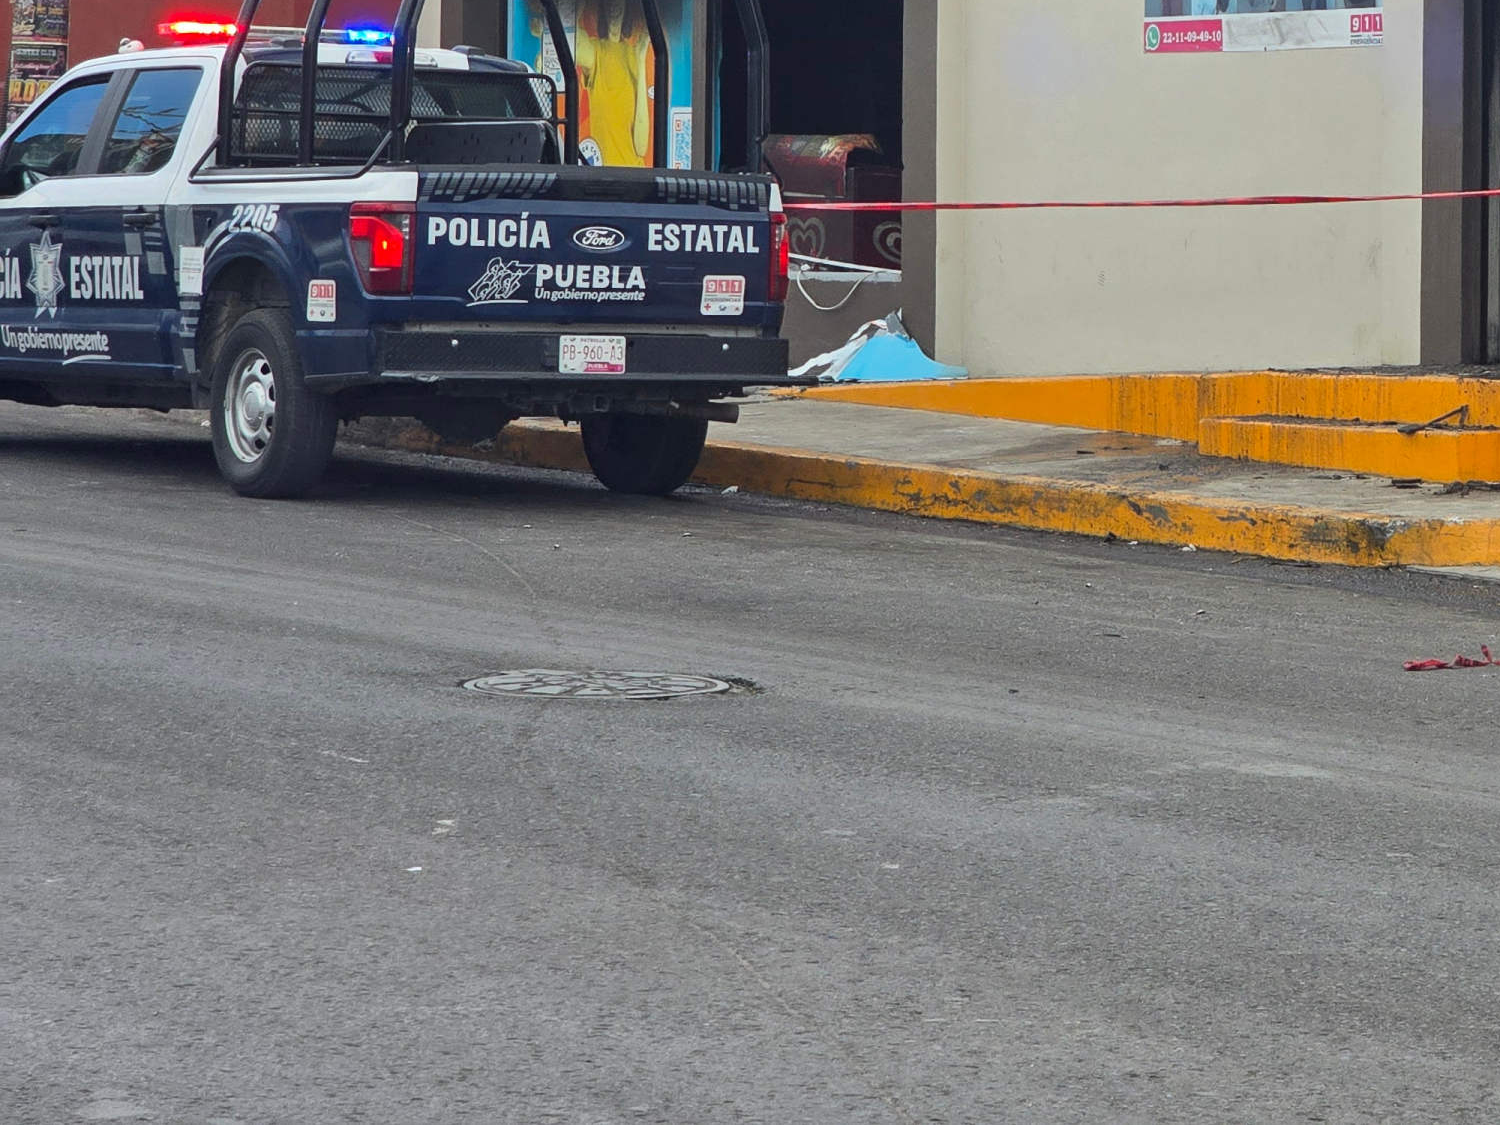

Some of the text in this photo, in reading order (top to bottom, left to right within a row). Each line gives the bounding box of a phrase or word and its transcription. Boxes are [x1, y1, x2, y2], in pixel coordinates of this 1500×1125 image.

[1352, 16, 1380, 31] 911
[228, 204, 280, 233] 2205
[428, 211, 759, 254] POLICÍA Ford ESTATAL
[70, 255, 144, 300] ESTATAL
[535, 263, 646, 289] PUEBLA
[707, 281, 738, 292] 911
[312, 285, 332, 297] 911
[535, 287, 645, 302] Un gobierno presente
[1, 324, 109, 355] Un gobierno presente
[562, 344, 624, 361] PB-960-A3
